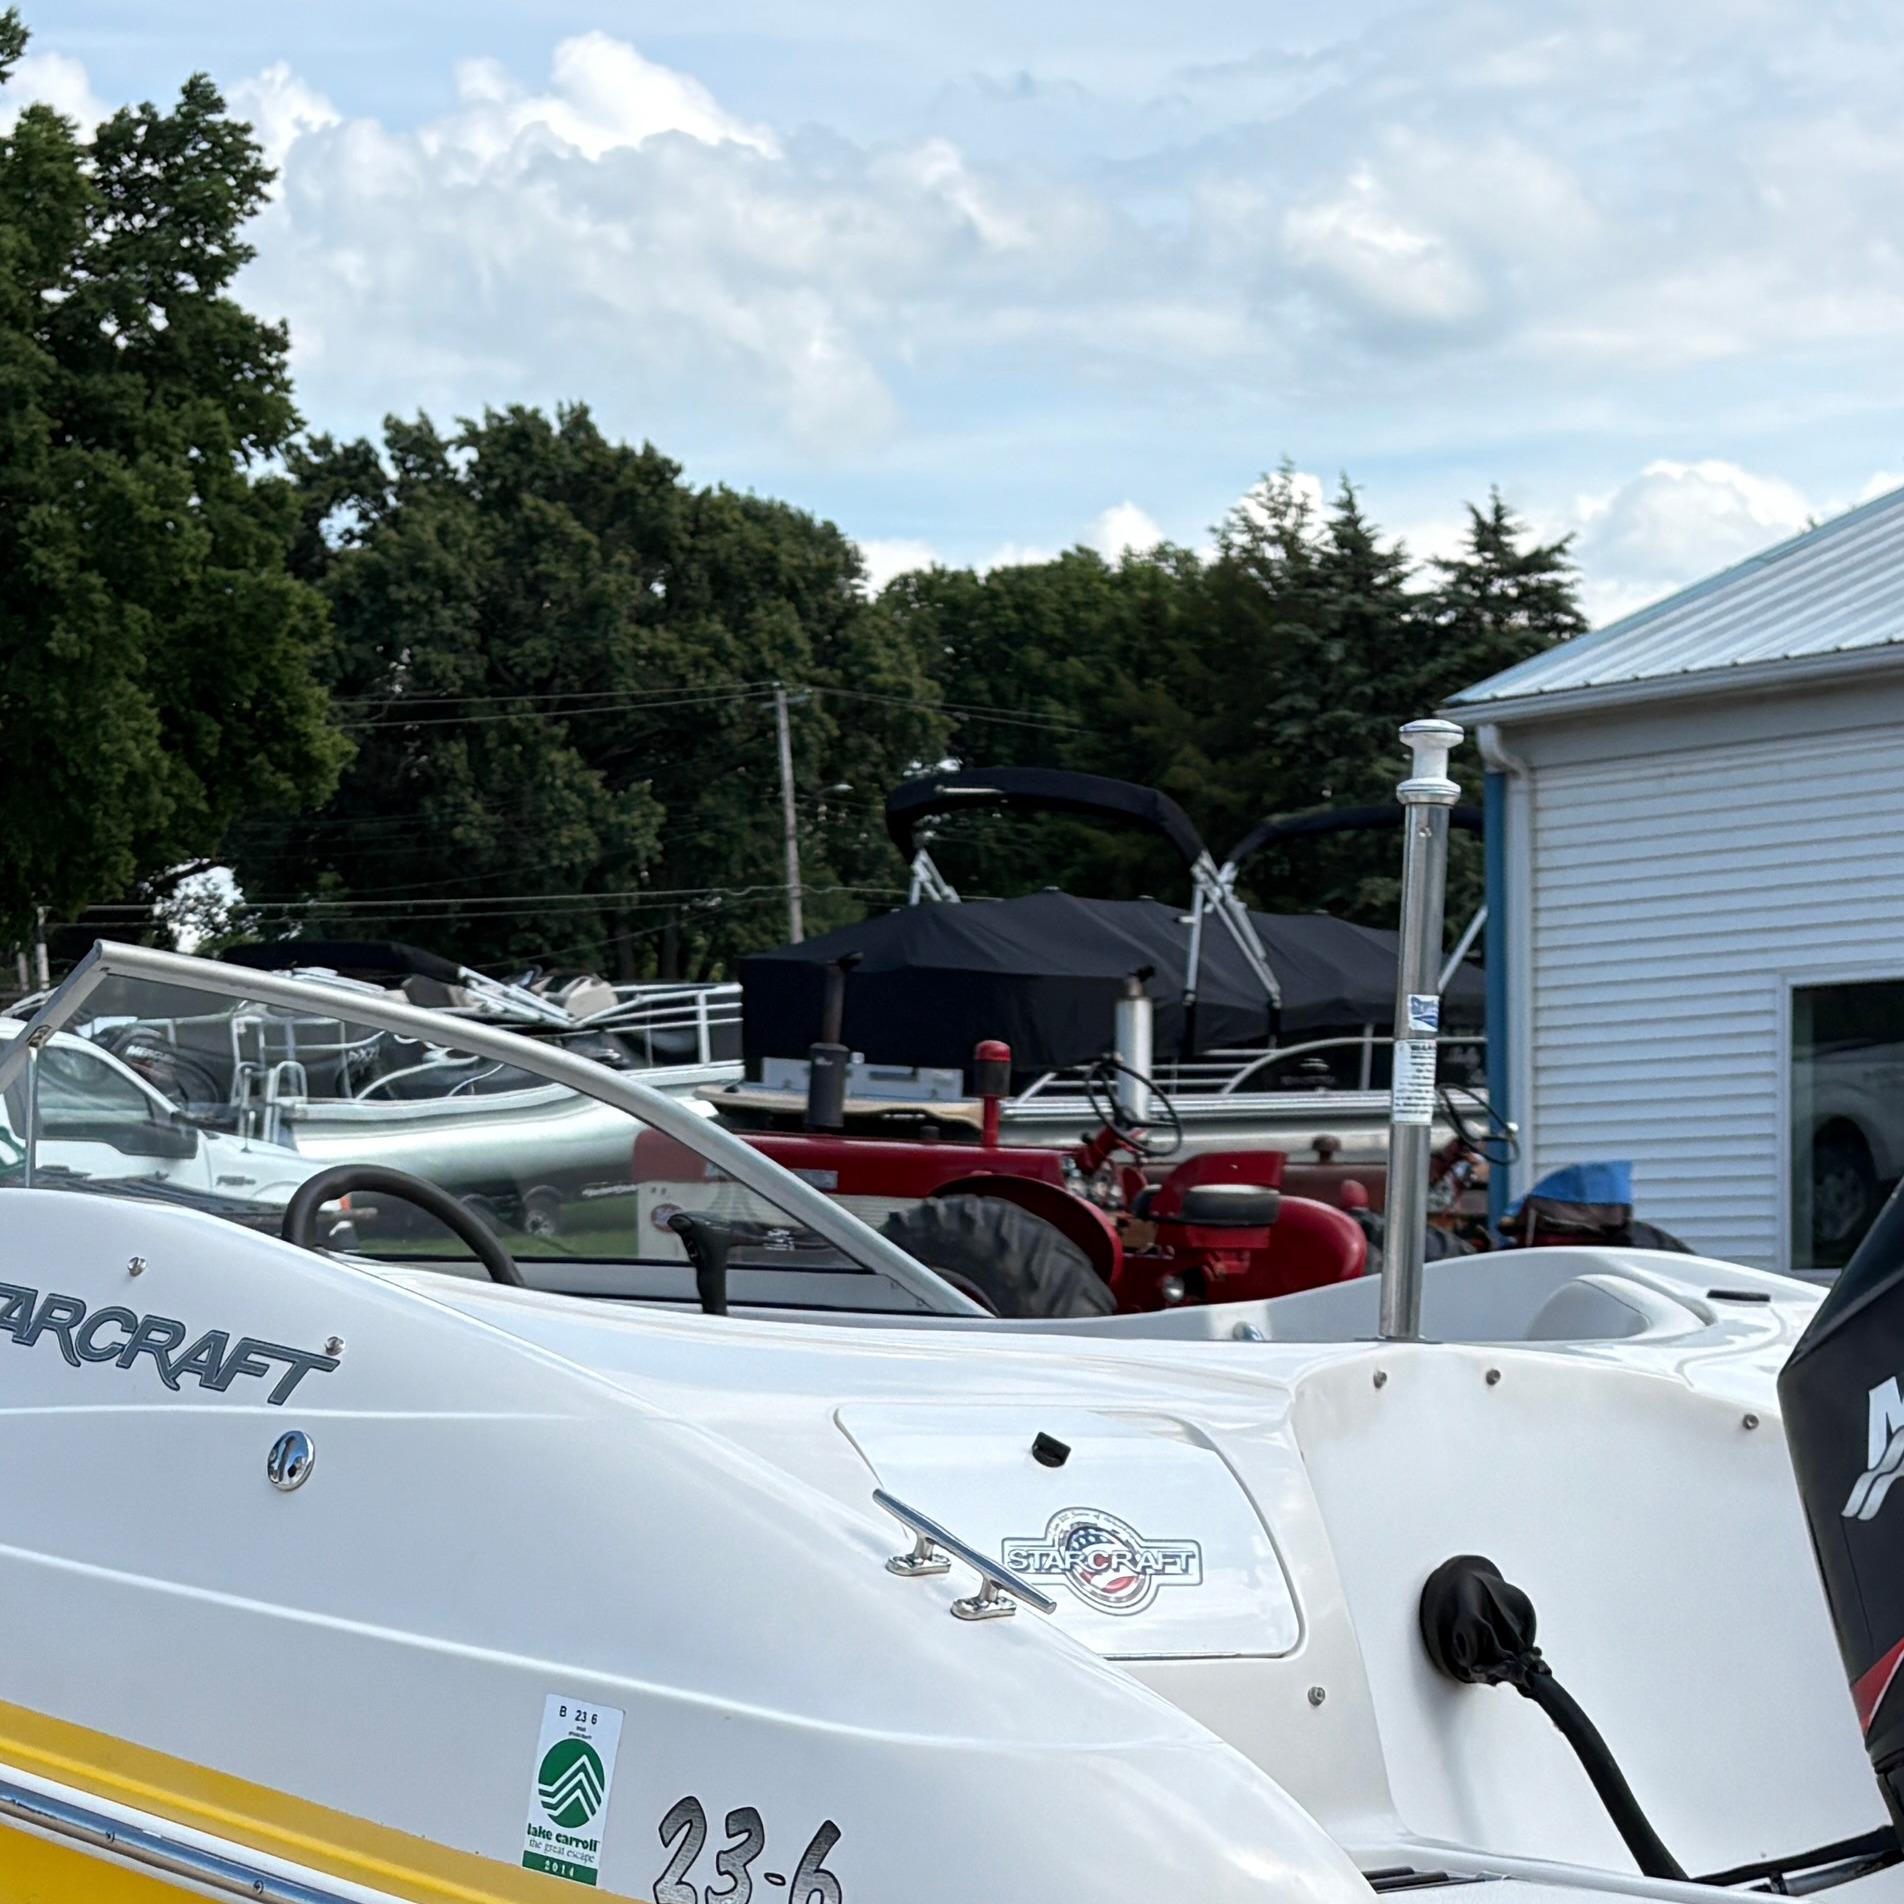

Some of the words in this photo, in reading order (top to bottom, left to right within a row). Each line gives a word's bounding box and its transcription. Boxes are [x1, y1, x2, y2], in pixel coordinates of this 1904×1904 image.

[1007, 1549, 1196, 1575] STARCRAFT
[560, 1705, 567, 1717] B
[575, 1710, 587, 1722] 23
[591, 1714, 598, 1725] 6
[527, 1823, 552, 1840] lake
[529, 1839, 542, 1849] the
[567, 1850, 595, 1863] escape
[544, 1860, 574, 1877] 2014
